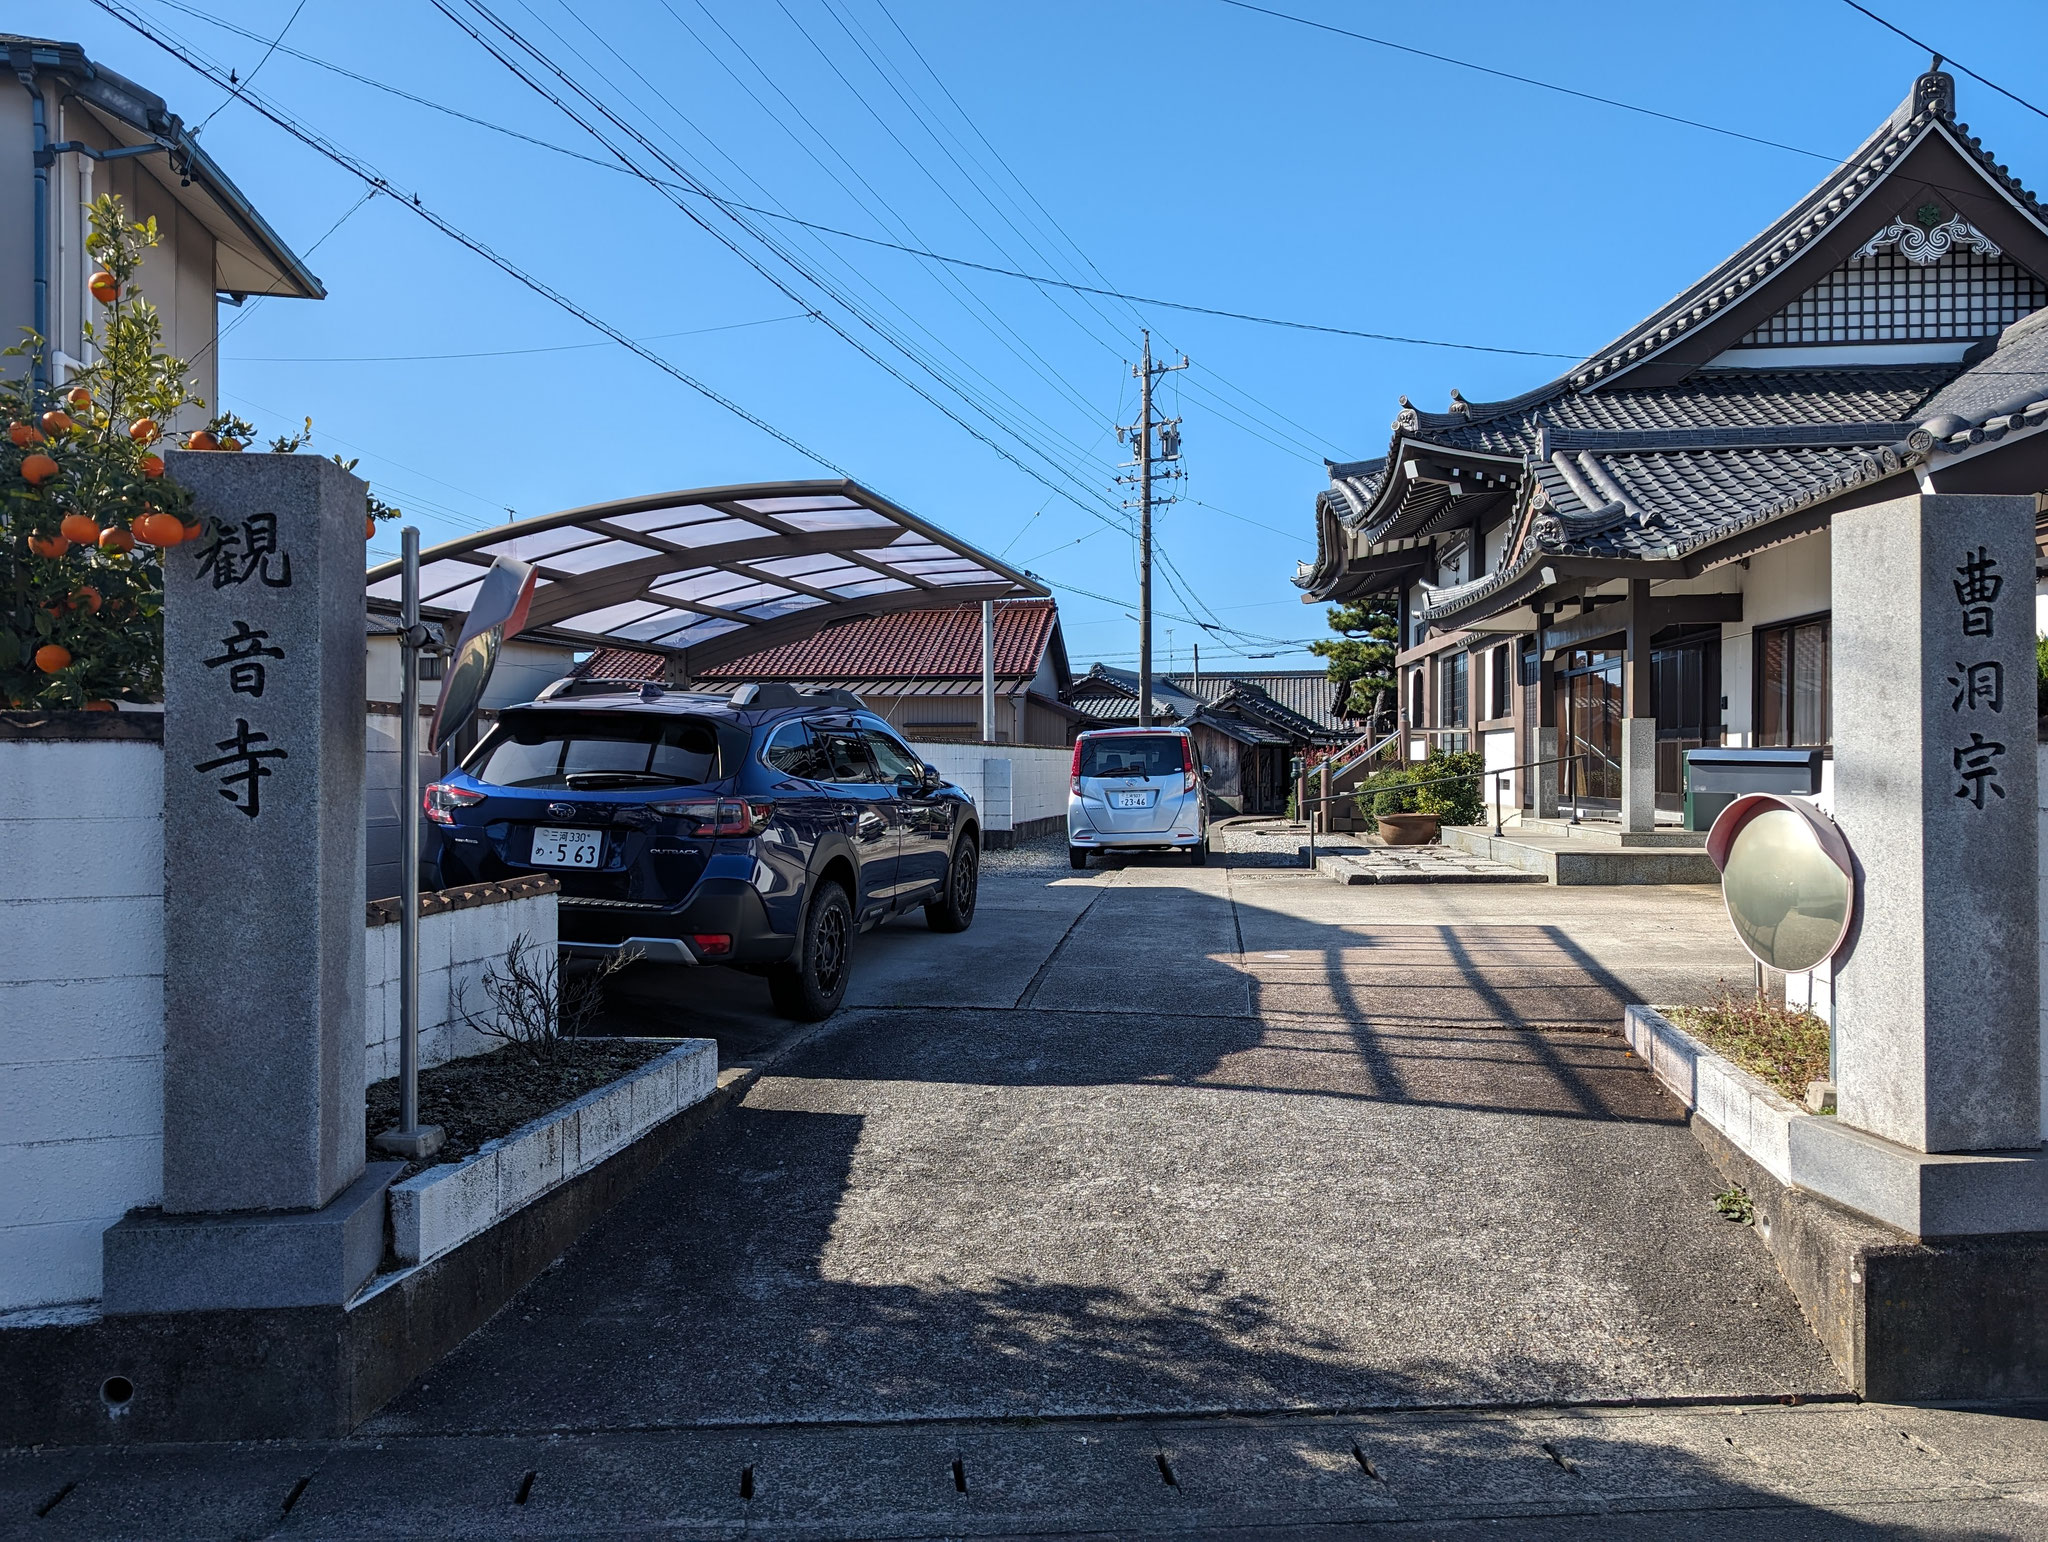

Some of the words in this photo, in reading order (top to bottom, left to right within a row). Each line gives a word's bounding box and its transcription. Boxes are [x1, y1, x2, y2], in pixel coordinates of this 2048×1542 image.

[194, 512, 292, 818] 観音寺
[1947, 546, 2006, 810] 曹洞宗
